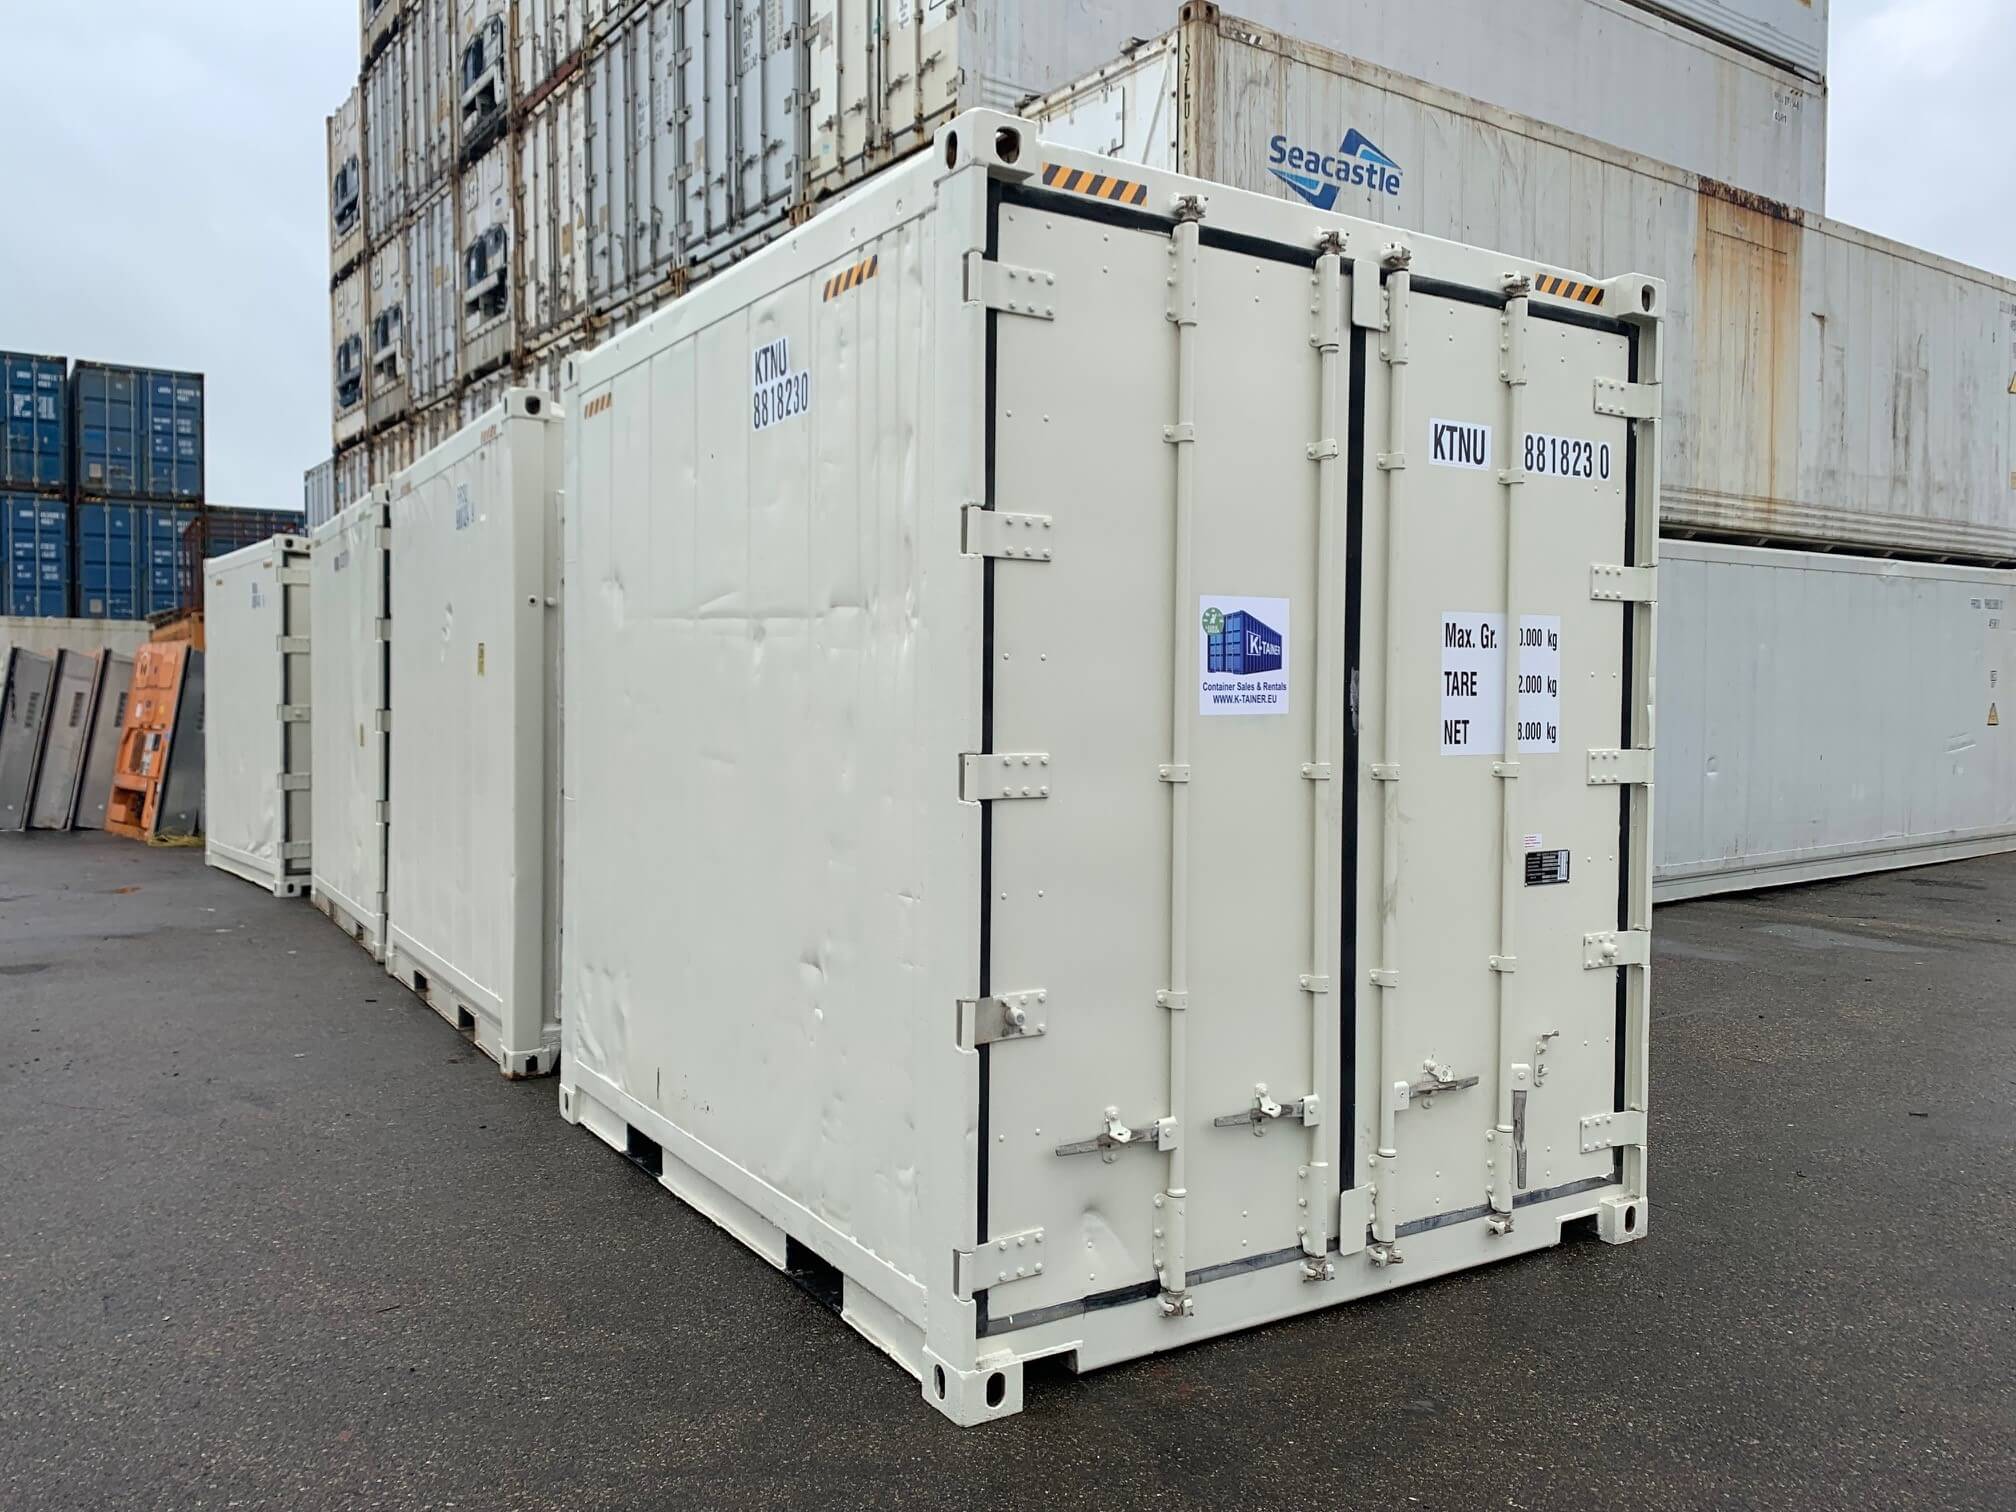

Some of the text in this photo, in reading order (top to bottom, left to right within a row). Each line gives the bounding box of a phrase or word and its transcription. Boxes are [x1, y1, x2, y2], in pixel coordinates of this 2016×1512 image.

[1269, 135, 1400, 196] Seacastle
[754, 338, 787, 386] KTNU
[753, 371, 808, 429] 8818230
[1433, 423, 1486, 465] KTNU
[1524, 434, 1592, 478] 881823
[1445, 622, 1476, 649] Max.
[1480, 623, 1497, 649] Gr.
[1547, 629, 1558, 651] kg
[1202, 682, 1287, 692] Container Sales & Rentals
[1212, 694, 1278, 704] WWW.K-TAINER.EU
[1444, 671, 1478, 697] TARE
[1547, 675, 1557, 698] kg
[1444, 719, 1470, 745] NET
[1546, 721, 1557, 744] kg
